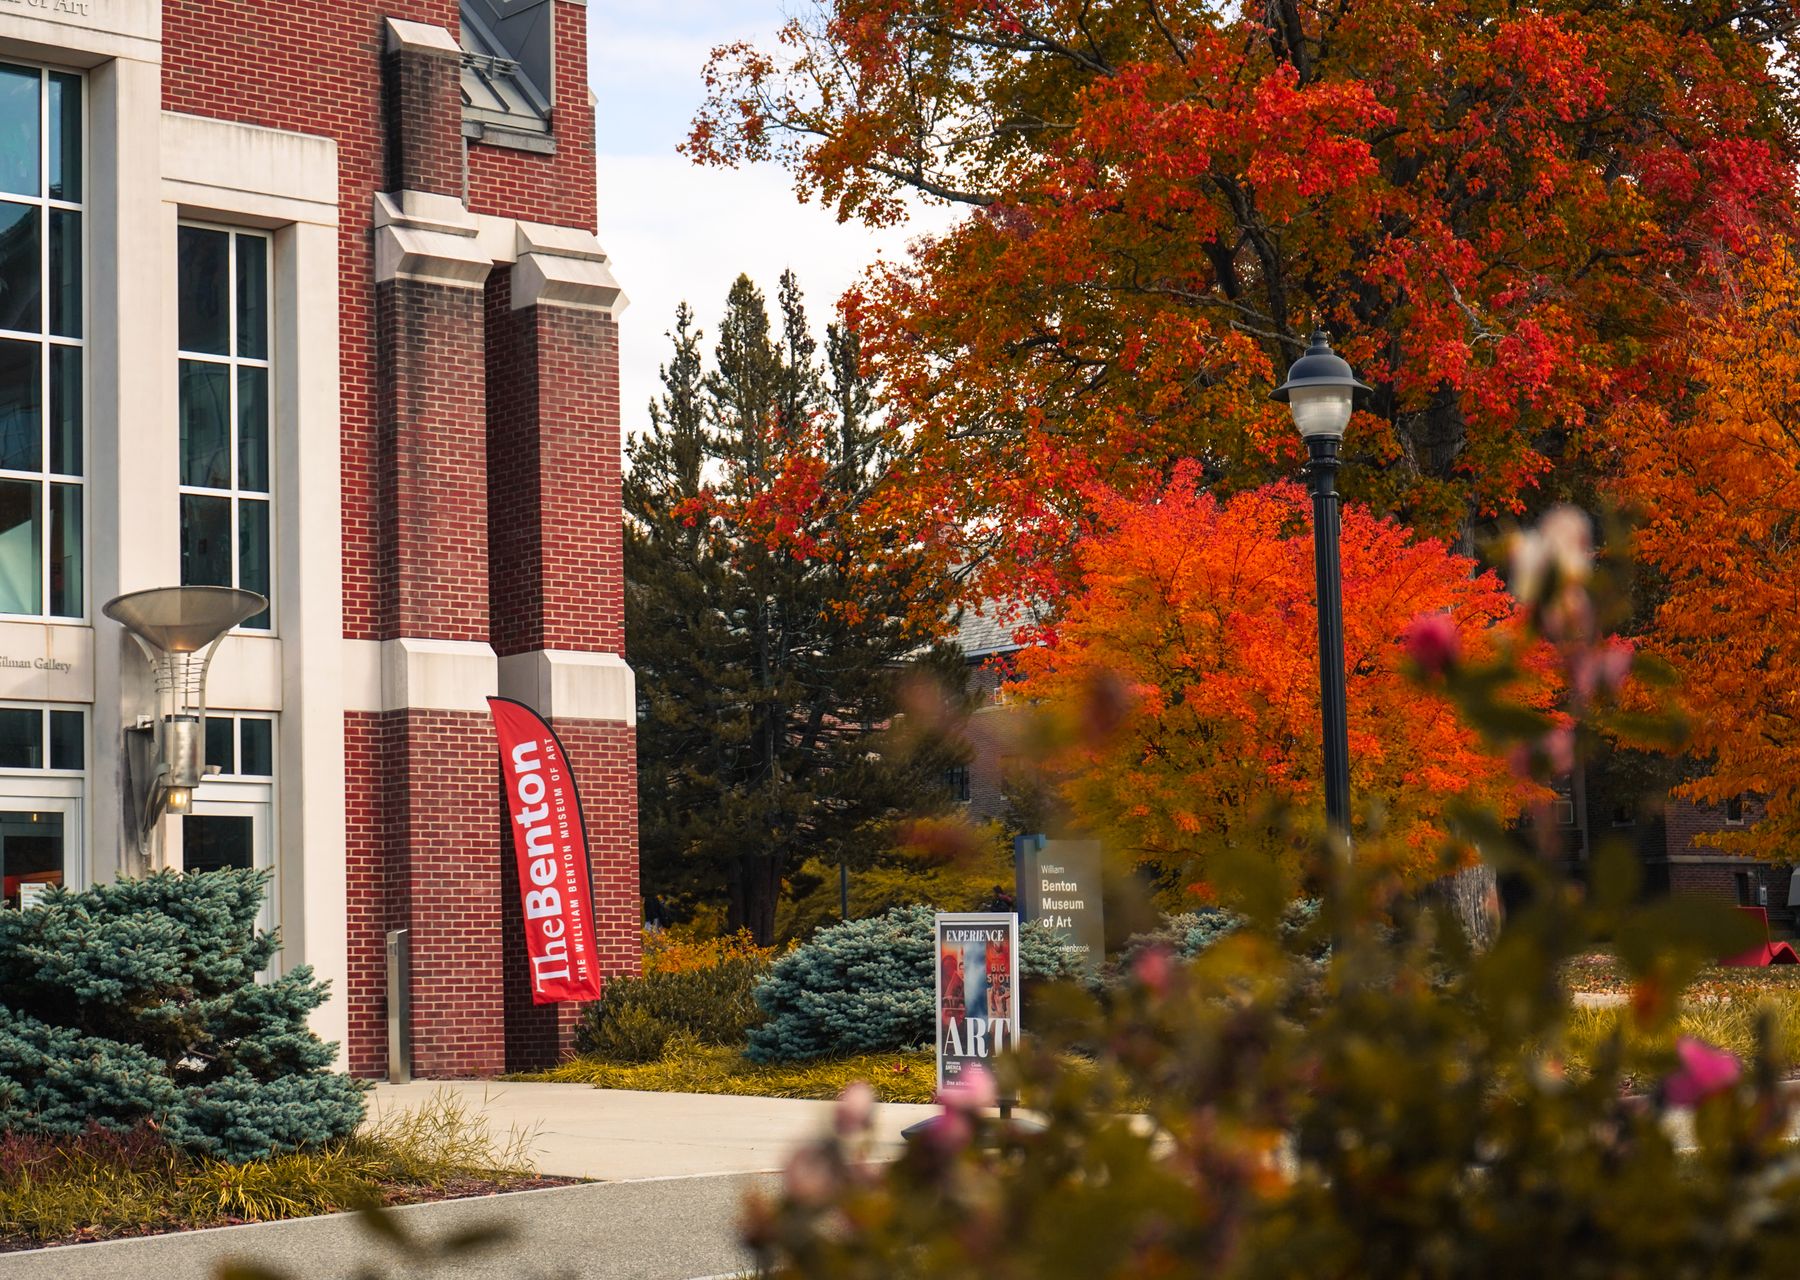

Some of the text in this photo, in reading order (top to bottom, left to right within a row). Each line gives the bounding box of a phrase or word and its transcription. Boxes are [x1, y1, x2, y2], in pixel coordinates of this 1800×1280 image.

[53, 0, 88, 16] Art
[0, 656, 71, 674] ilman Gallery
[544, 738, 588, 981] THE WILLIAM BENTON MUSEUM OF ART
[1040, 864, 1065, 874] William
[1041, 879, 1077, 892] Benton
[1042, 898, 1084, 910] Museum
[1043, 915, 1072, 928] of Art
[946, 930, 1004, 942] EXPERIENCE
[991, 964, 1006, 973] BIG
[987, 973, 1010, 983] SHOT
[942, 1016, 1011, 1058] ART
